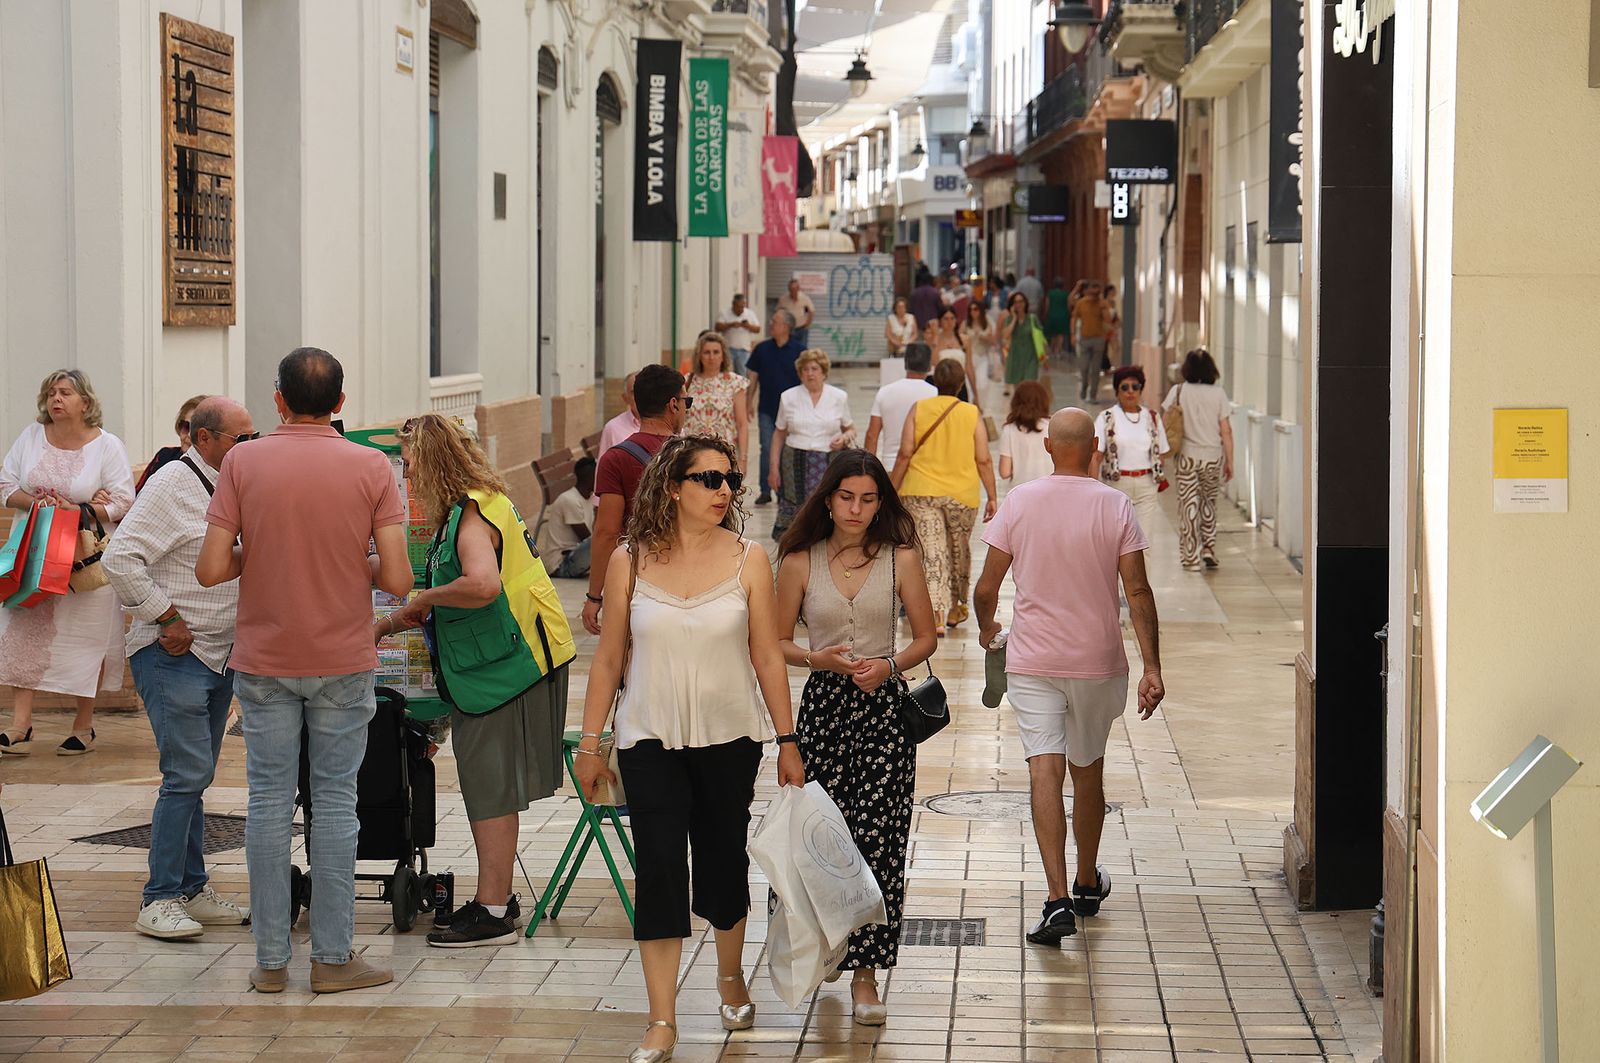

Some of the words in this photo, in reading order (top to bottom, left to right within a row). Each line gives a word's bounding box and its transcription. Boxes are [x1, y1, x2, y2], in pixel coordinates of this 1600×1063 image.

[174, 53, 198, 136] La
[648, 73, 667, 138] BIMBA
[695, 79, 709, 112] LAS
[647, 139, 665, 155] Y
[695, 117, 709, 140] DE
[709, 104, 723, 192] CARCASAS
[646, 157, 665, 206] LOLA
[695, 142, 709, 187] CASA
[695, 191, 709, 216] LA
